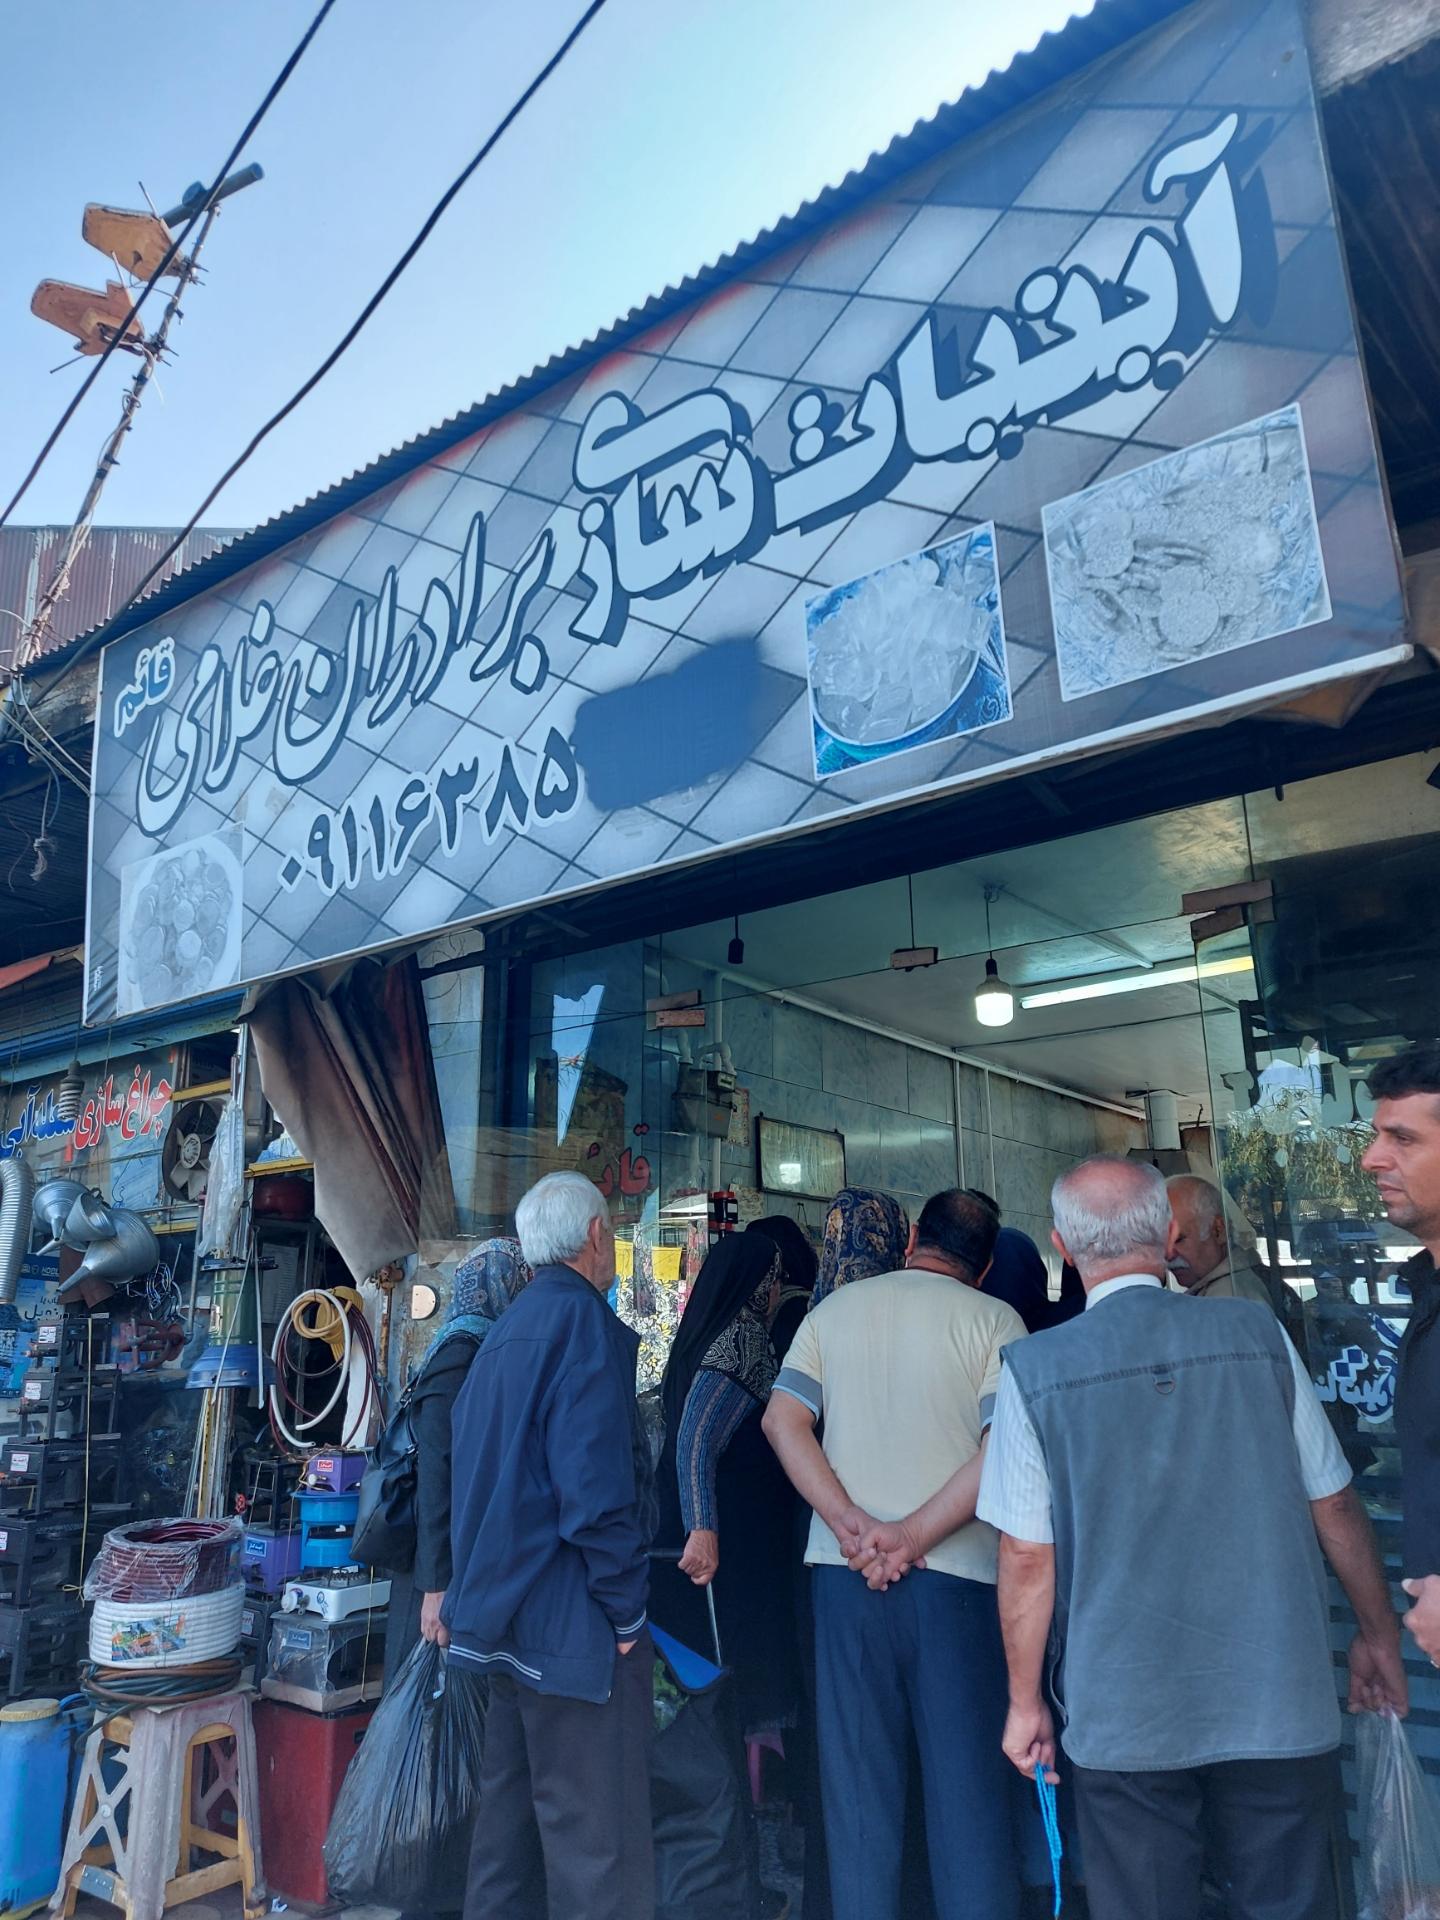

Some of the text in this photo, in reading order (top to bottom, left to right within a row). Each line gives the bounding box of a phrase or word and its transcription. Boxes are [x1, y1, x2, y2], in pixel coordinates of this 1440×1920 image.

[136, 111, 1245, 838] آبنبات سازی برادران غلامی
[114, 637, 176, 738] قائم
[74, 1074, 125, 1150] سازی
[120, 1064, 173, 1141] چراغ
[586, 1122, 651, 1197] قائ
